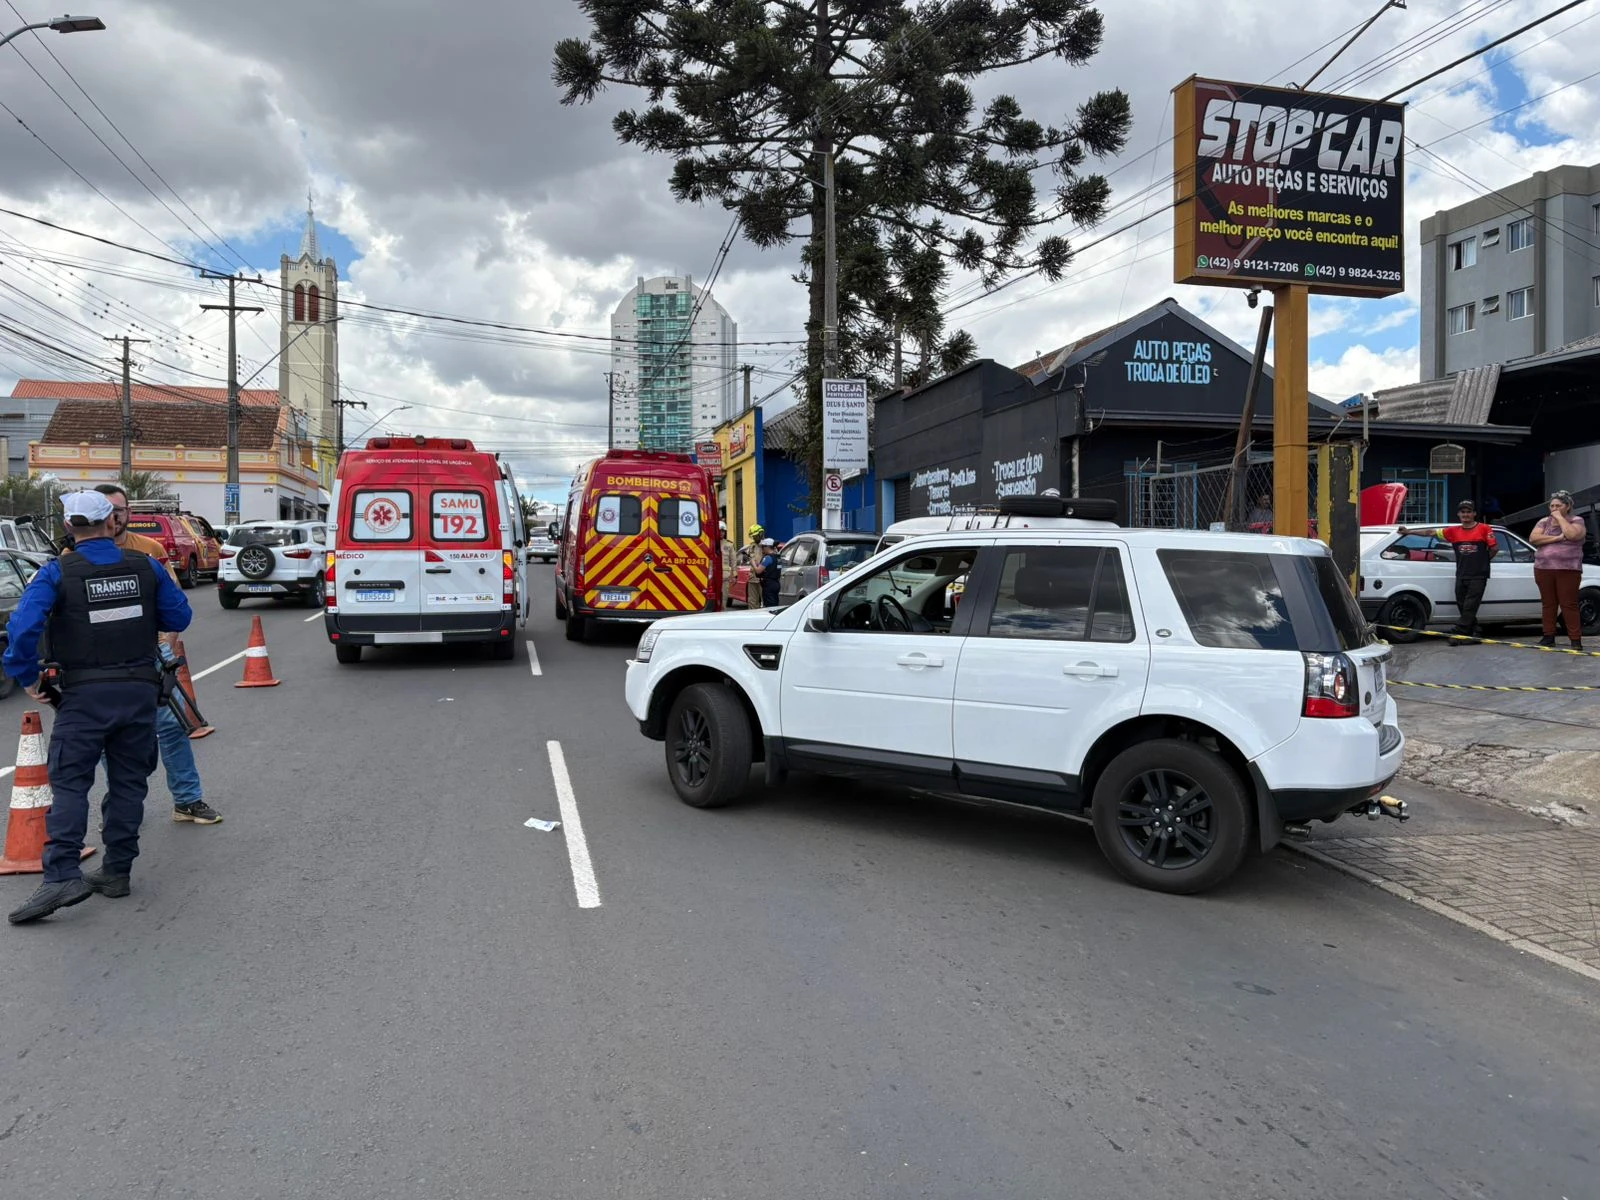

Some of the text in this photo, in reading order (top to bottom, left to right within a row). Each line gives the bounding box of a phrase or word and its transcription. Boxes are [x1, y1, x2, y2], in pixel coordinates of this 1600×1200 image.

[1197, 98, 1403, 177] STOP'CAR
[1212, 163, 1388, 201] AUTO PEÇAS E SERVIÇOS
[1228, 200, 1373, 227] As melhores marcas e o
[1200, 220, 1398, 251] melhor preço você encontra aqui!
[1209, 256, 1401, 281] (42) 9 9121-7206 (42) 9 9824-3226
[1133, 339, 1211, 363] AUTO PEÇAS
[1124, 361, 1210, 384] TROCA DE ÓLEO
[827, 383, 863, 392] IGREJA
[826, 400, 841, 408] DEUS
[842, 399, 846, 408] É
[607, 476, 678, 490] BOMBEIROS
[440, 499, 479, 509] SAMU
[440, 514, 478, 534] 192
[336, 552, 365, 560] MÉDICO
[687, 557, 705, 565] 0245
[90, 580, 136, 595] TRÂNSITO
